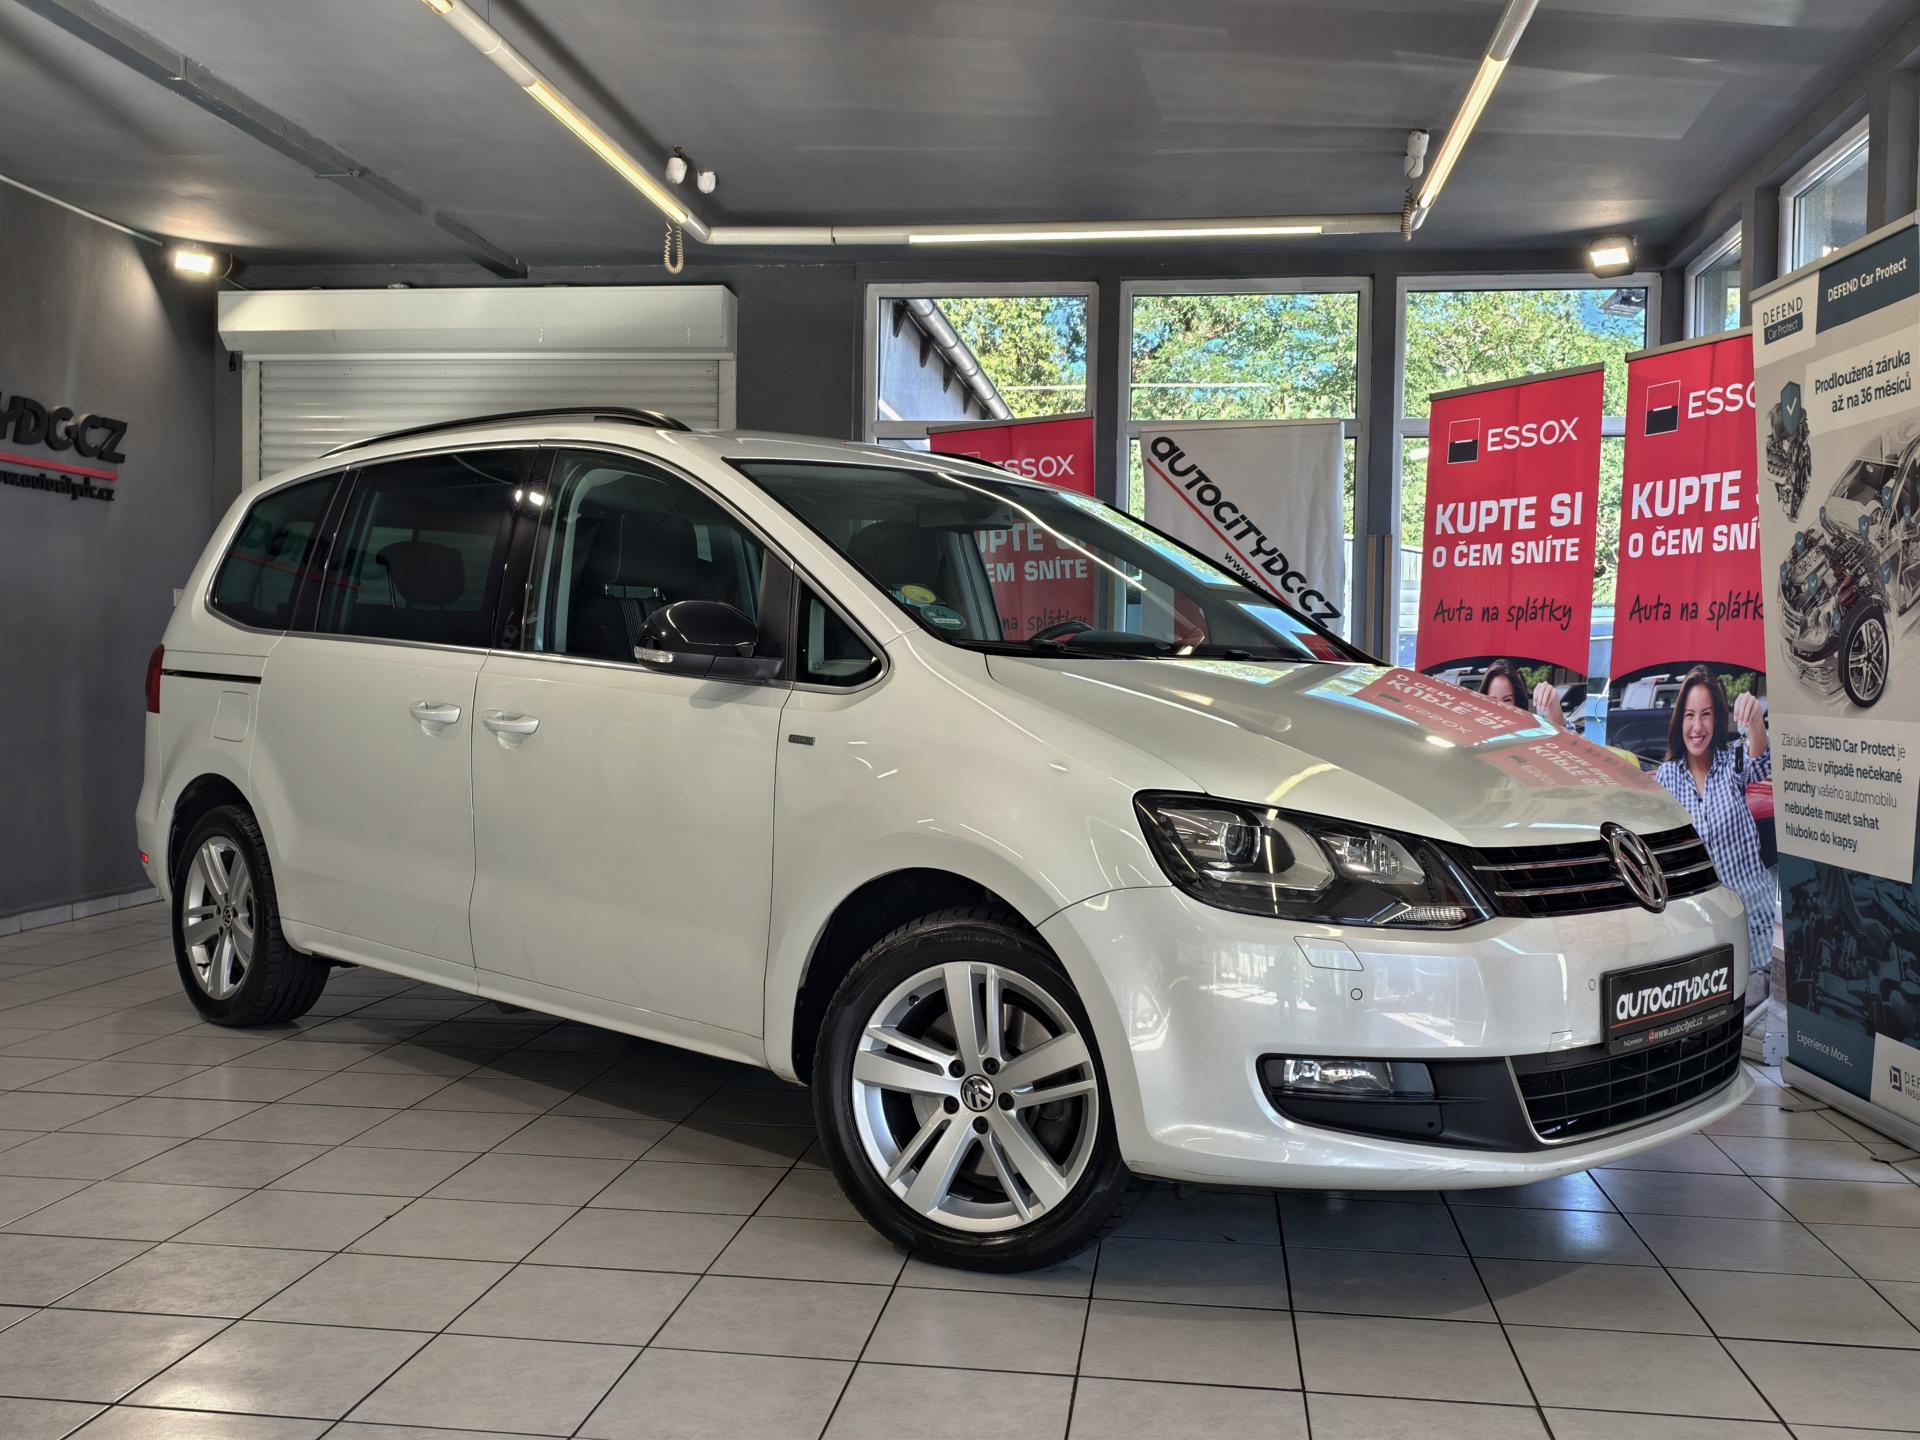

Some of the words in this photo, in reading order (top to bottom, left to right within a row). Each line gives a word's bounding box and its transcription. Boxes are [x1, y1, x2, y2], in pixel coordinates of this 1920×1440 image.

[1827, 278, 1859, 302] DEFEND
[1859, 273, 1874, 288] Car
[1875, 257, 1908, 282] Protect
[1763, 297, 1803, 326] DEFEND
[1767, 327, 1777, 340] Car
[1777, 319, 1799, 334] Protect
[1815, 360, 1873, 395] Prodloužená
[1876, 350, 1910, 375] záruka
[1832, 394, 1844, 413] až
[1846, 394, 1859, 409] na
[1860, 386, 1872, 405] 36
[1874, 371, 1911, 400] měsíců
[1487, 417, 1579, 451] ESSOX
[994, 454, 1075, 479] SSOX
[1631, 470, 1742, 520] KUPTE
[1435, 496, 1537, 535] KUPTE
[1550, 491, 1583, 528] SI
[1432, 546, 1447, 568] O
[1453, 540, 1503, 567] ČEM
[1511, 535, 1580, 565] SNÍTE
[1627, 533, 1644, 558] O
[1651, 525, 1703, 556] ČEM
[1712, 516, 1760, 552] SNÍ
[984, 562, 1015, 583] EM
[1024, 556, 1088, 581] SNÍTE
[1433, 598, 1473, 623] Auta
[1481, 606, 1499, 623] na
[1506, 596, 1572, 631] splátky
[1629, 595, 1671, 623] Auta
[1680, 602, 1699, 622] na
[1707, 590, 1763, 631] splátk
[1781, 732, 1807, 747] Záruka
[1808, 736, 1841, 751] DEFEND
[1843, 739, 1858, 753] Car
[1861, 741, 1896, 757] Protect
[1897, 743, 1906, 761] je
[1782, 755, 1806, 773] jistota,
[1807, 758, 1816, 772] že
[1818, 762, 1822, 772] v
[1824, 761, 1854, 778] případě
[1856, 765, 1903, 783] nečekané
[1784, 780, 1816, 798] poruchy
[1817, 784, 1843, 800] vašeho
[1845, 789, 1897, 808] automobilu
[1785, 802, 1823, 819] nebudete
[1825, 810, 1851, 825] muset
[1853, 813, 1879, 830] sahat
[1786, 822, 1818, 841] hluboko
[1820, 830, 1831, 845] do
[1796, 1030, 1829, 1056] Experience
